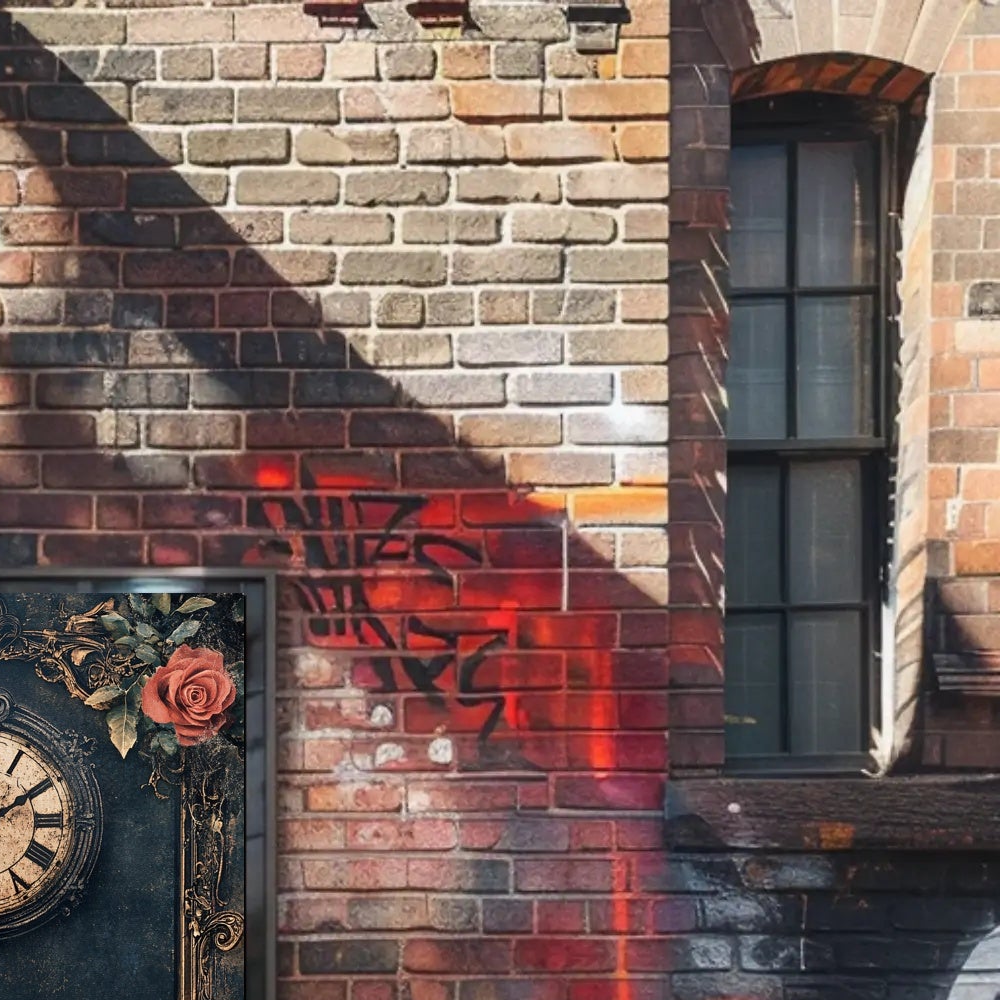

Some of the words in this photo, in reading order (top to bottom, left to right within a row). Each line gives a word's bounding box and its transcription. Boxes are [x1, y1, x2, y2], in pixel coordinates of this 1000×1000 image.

[6, 749, 25, 777] I
[25, 776, 54, 800] II
[34, 812, 62, 830] III
[10, 869, 32, 894] V
